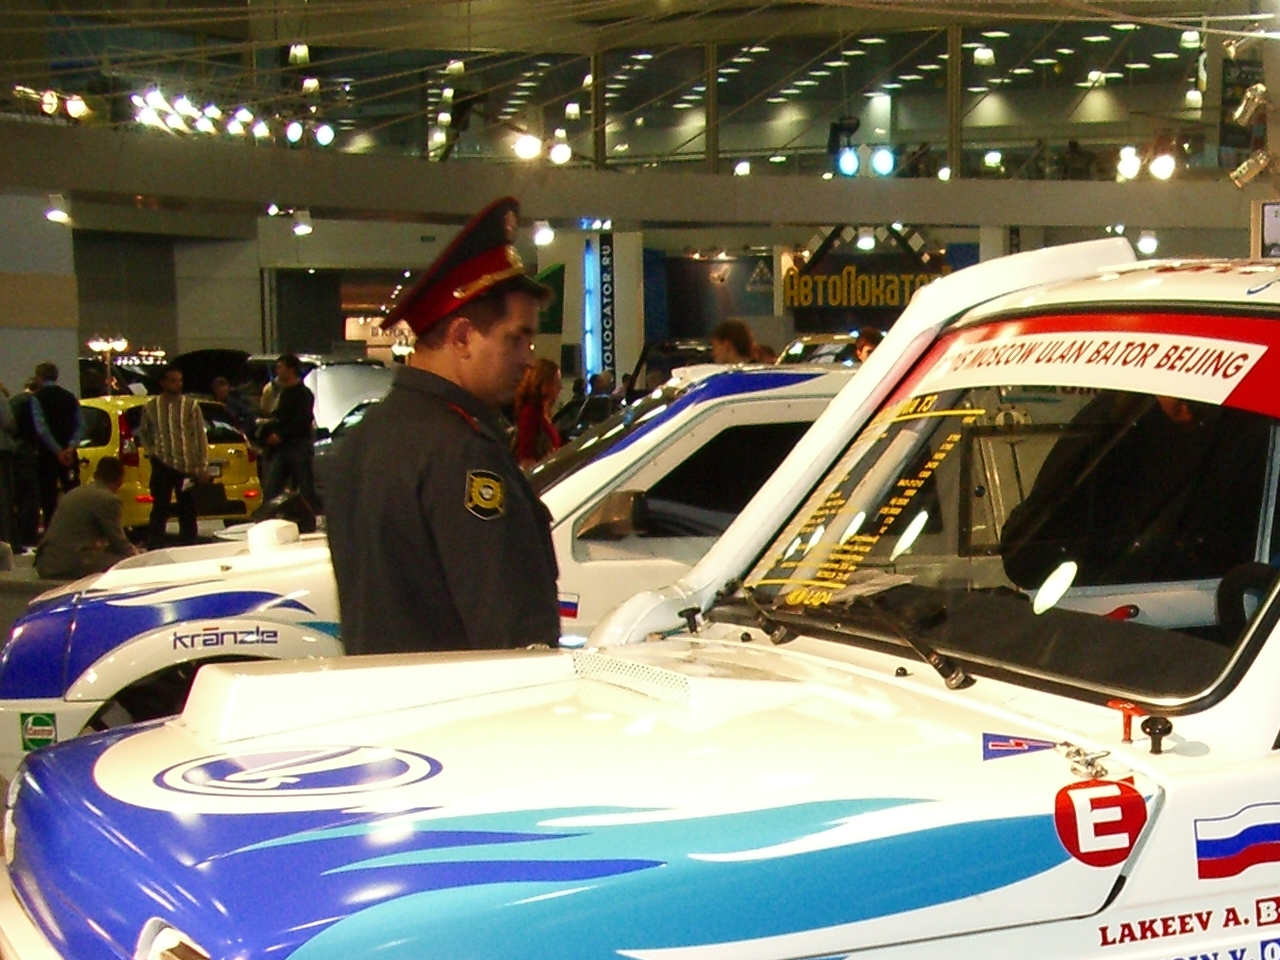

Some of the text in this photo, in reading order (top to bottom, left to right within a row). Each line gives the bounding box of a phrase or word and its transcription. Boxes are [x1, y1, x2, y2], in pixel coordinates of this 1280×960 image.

[784, 265, 941, 306] АвтоЛокато
[601, 244, 613, 373] TOLOCATOR.RU
[962, 341, 1043, 370] MOSCOW
[1034, 340, 1094, 364] ULAN
[1087, 340, 1158, 368] BATOR
[1153, 344, 1249, 380] BEIJING
[1068, 784, 1131, 854] E
[1098, 910, 1213, 946] LAKEEV
[1222, 907, 1250, 928] A.
